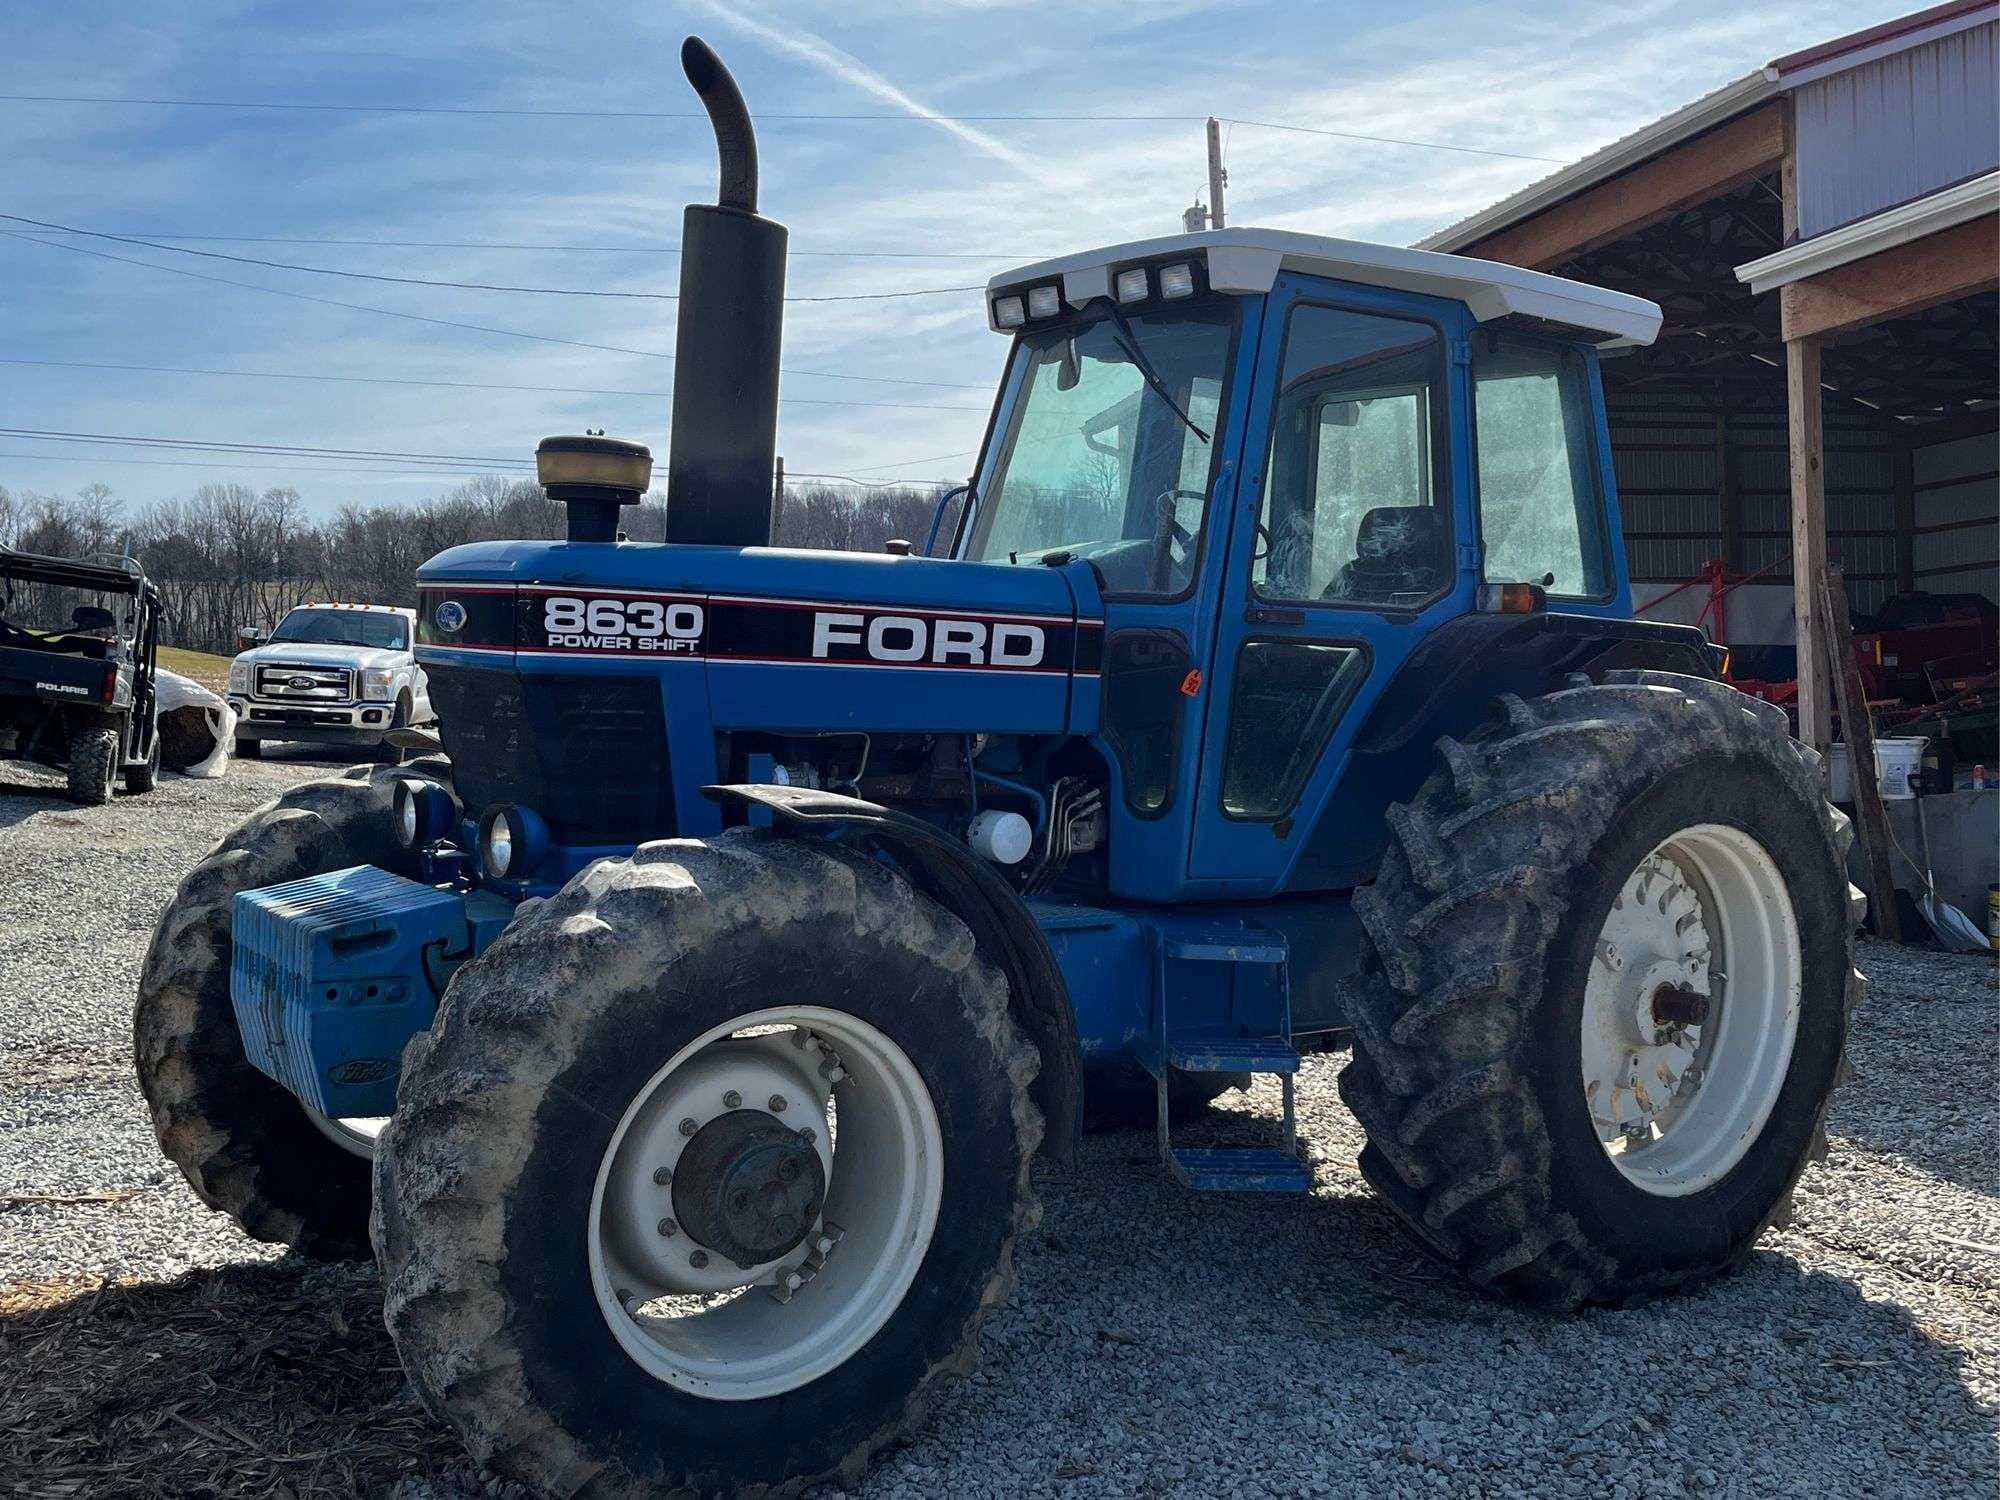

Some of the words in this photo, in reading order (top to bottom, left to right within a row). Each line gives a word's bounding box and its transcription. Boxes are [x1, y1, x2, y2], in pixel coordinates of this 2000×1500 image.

[543, 597, 704, 638] 8630
[547, 634, 632, 650] POWER
[637, 636, 699, 652] SHIFT
[812, 612, 1045, 667] FORD
[36, 681, 89, 695] POLARIS
